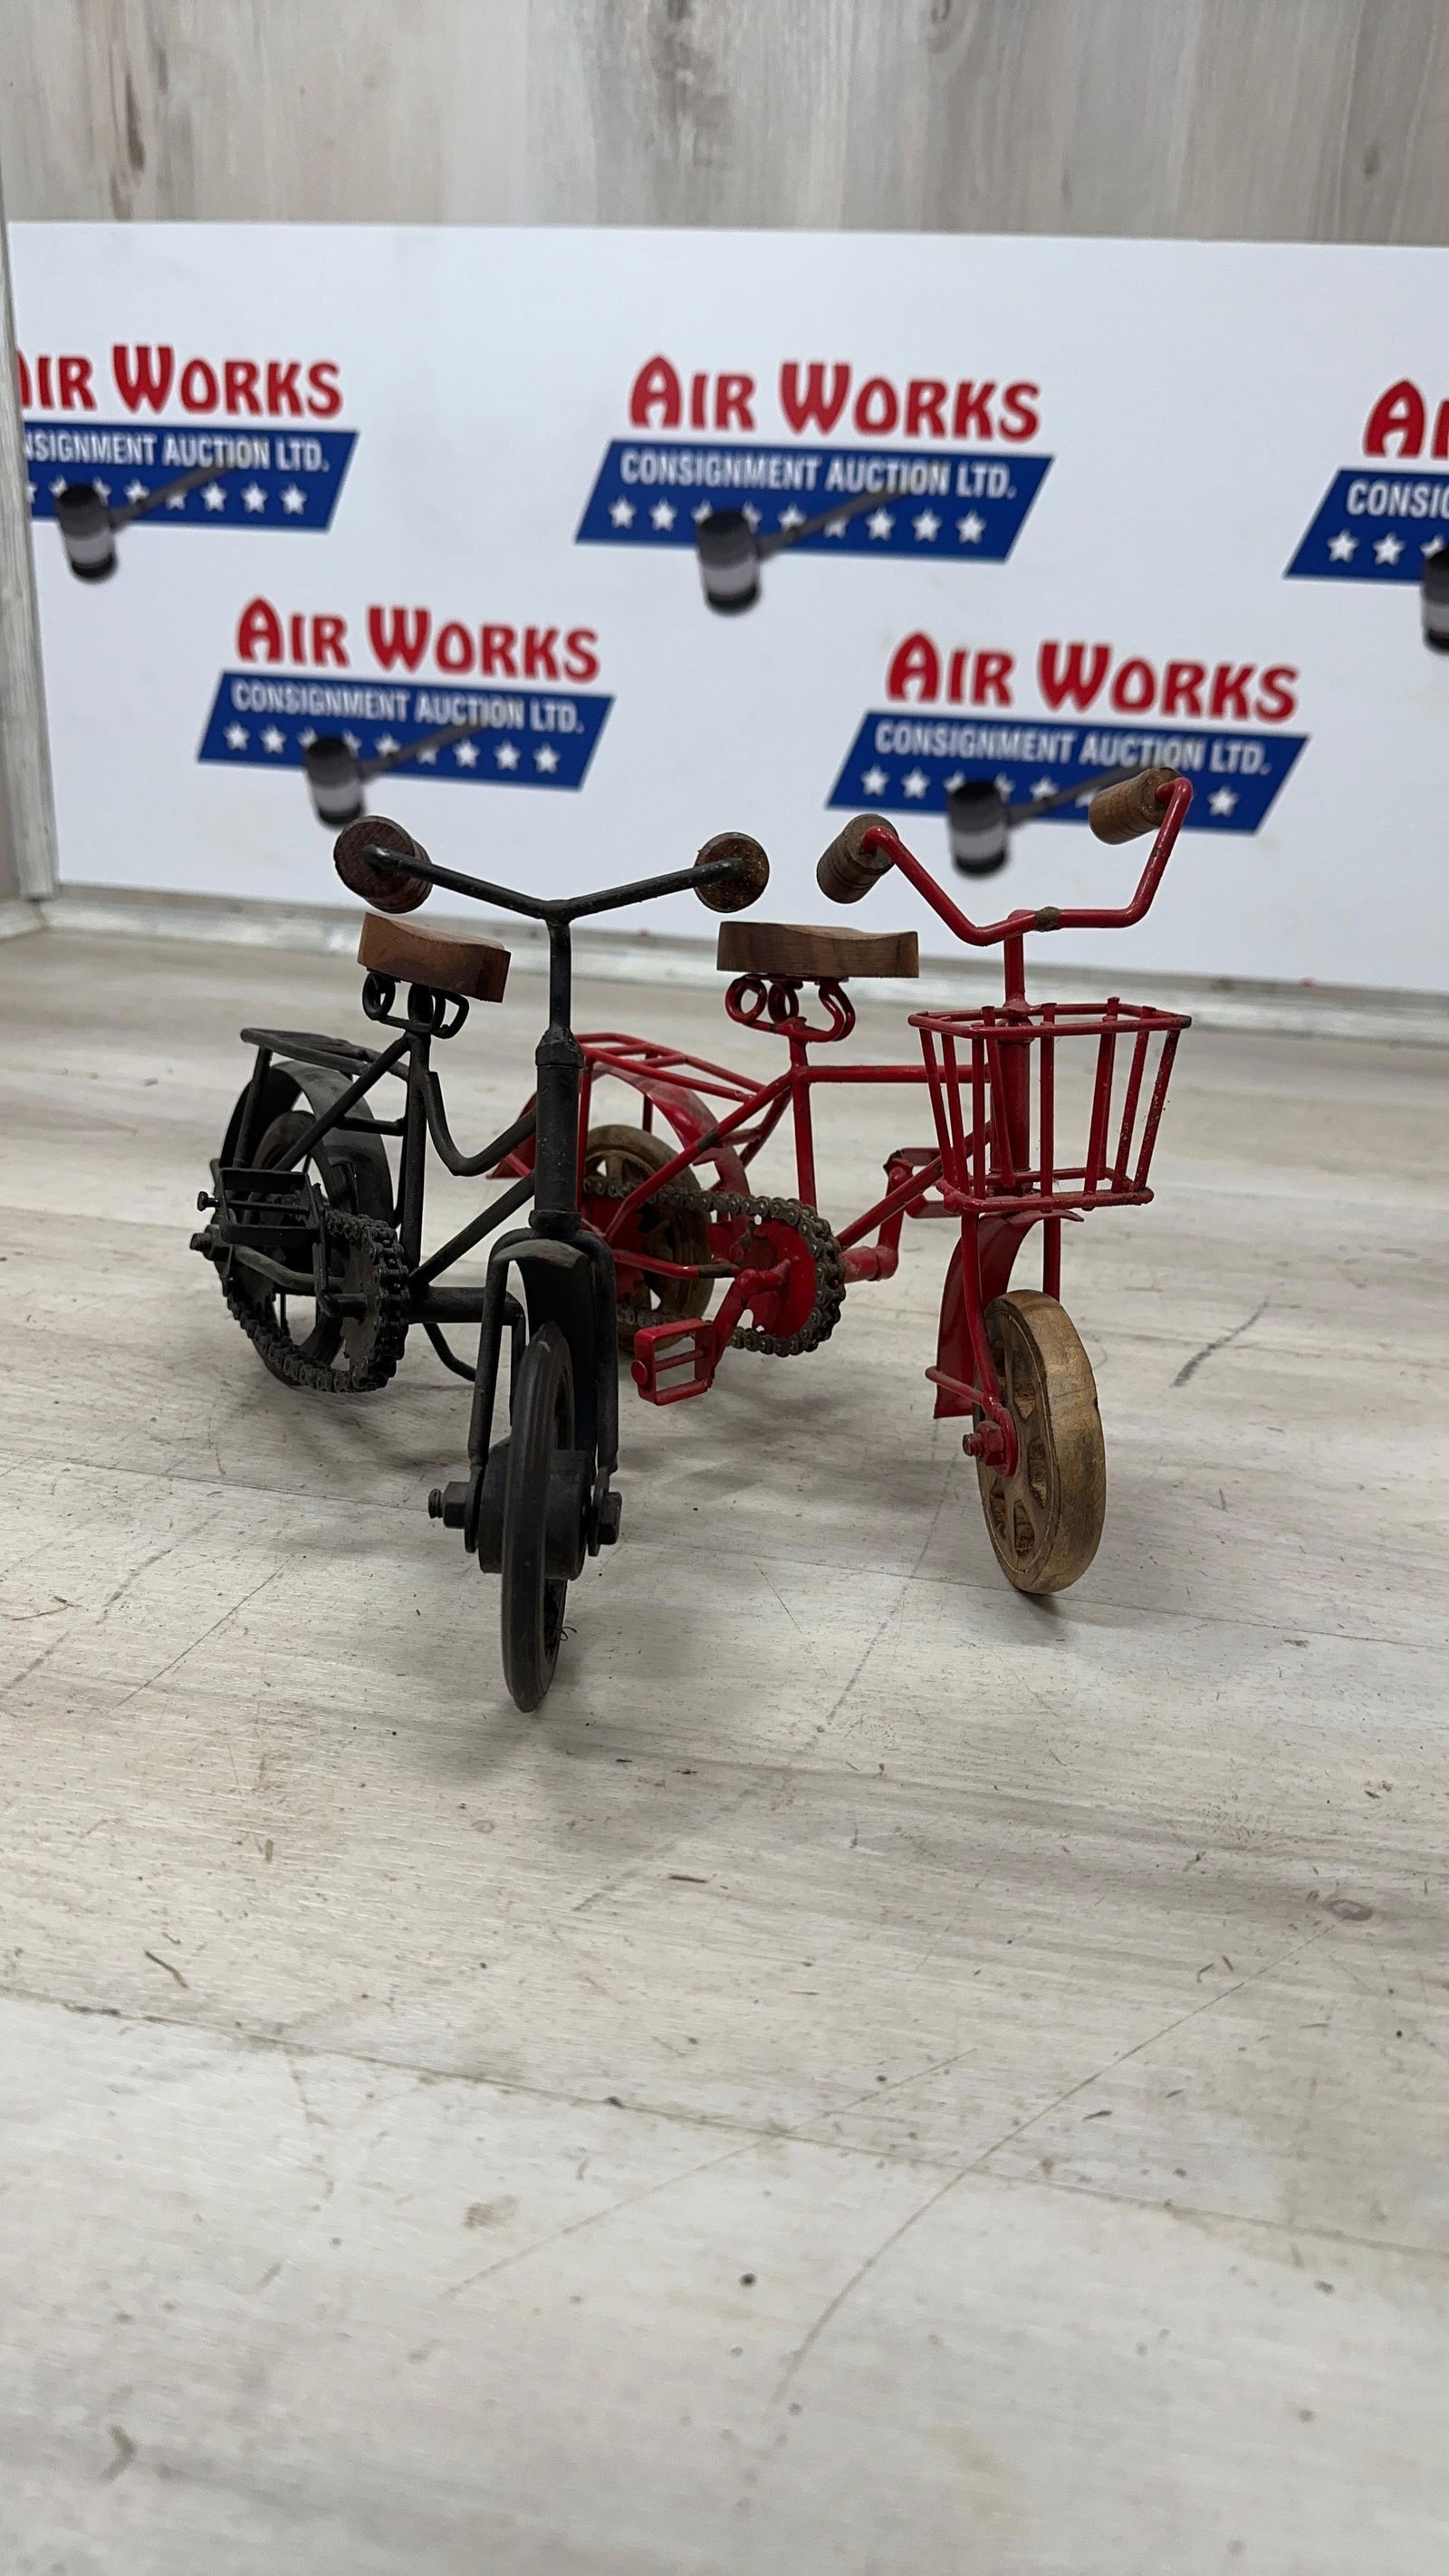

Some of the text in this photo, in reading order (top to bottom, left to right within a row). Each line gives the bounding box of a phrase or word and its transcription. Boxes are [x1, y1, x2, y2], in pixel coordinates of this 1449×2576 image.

[629, 354, 1041, 444] AIR WORKS
[162, 433, 271, 469] AUCTION
[275, 437, 330, 473] LTD.
[619, 449, 1016, 500] CONSIGNMENT AUCTION LTD.
[235, 596, 601, 683] AIR WORKS
[886, 630, 1300, 723] AIR WORKS
[230, 680, 585, 735] CONSIGNMENT AUCTION LTD.
[874, 721, 1272, 775] CONSIGNMENT AUCTION LTD.
